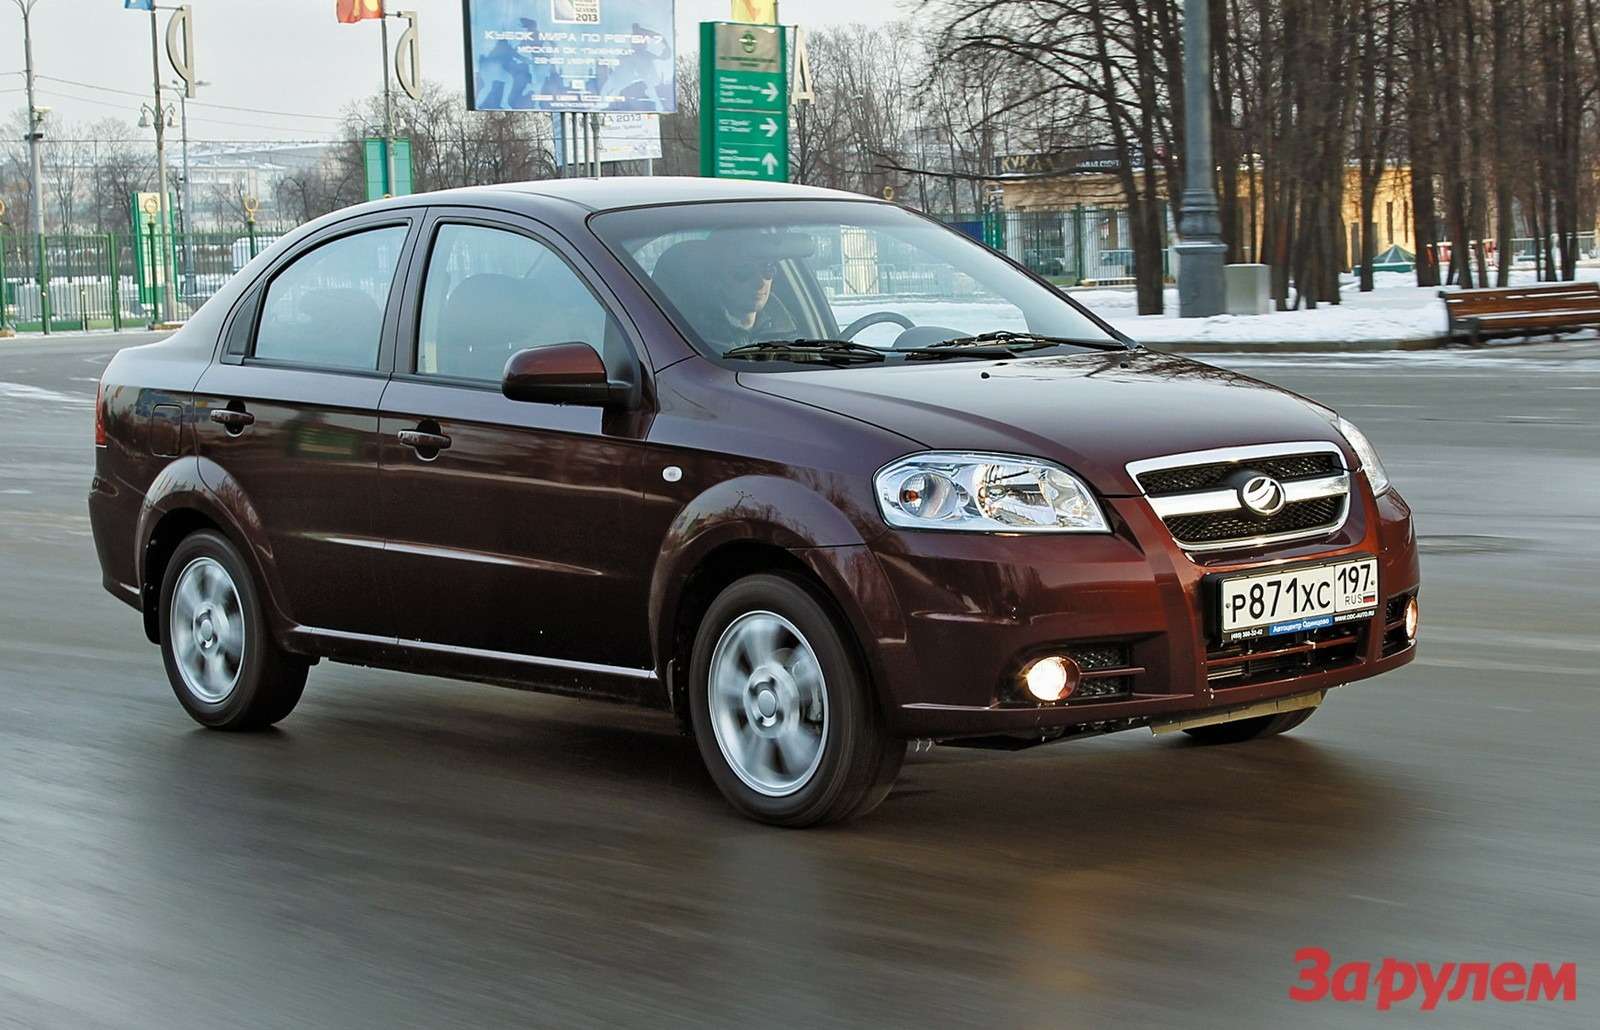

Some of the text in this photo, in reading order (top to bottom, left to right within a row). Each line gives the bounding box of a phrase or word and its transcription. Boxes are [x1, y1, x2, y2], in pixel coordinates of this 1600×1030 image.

[575, 13, 598, 22] 2013
[484, 30, 535, 41] КУБОК
[538, 32, 576, 42] МИРА
[580, 33, 600, 42] ПО
[615, 112, 642, 122] 2013
[1232, 563, 1371, 623] Р871ХС 197
[1344, 593, 1362, 606] RUS
[1272, 622, 1302, 633] Автоцентр
[1302, 618, 1330, 628] Одинцово
